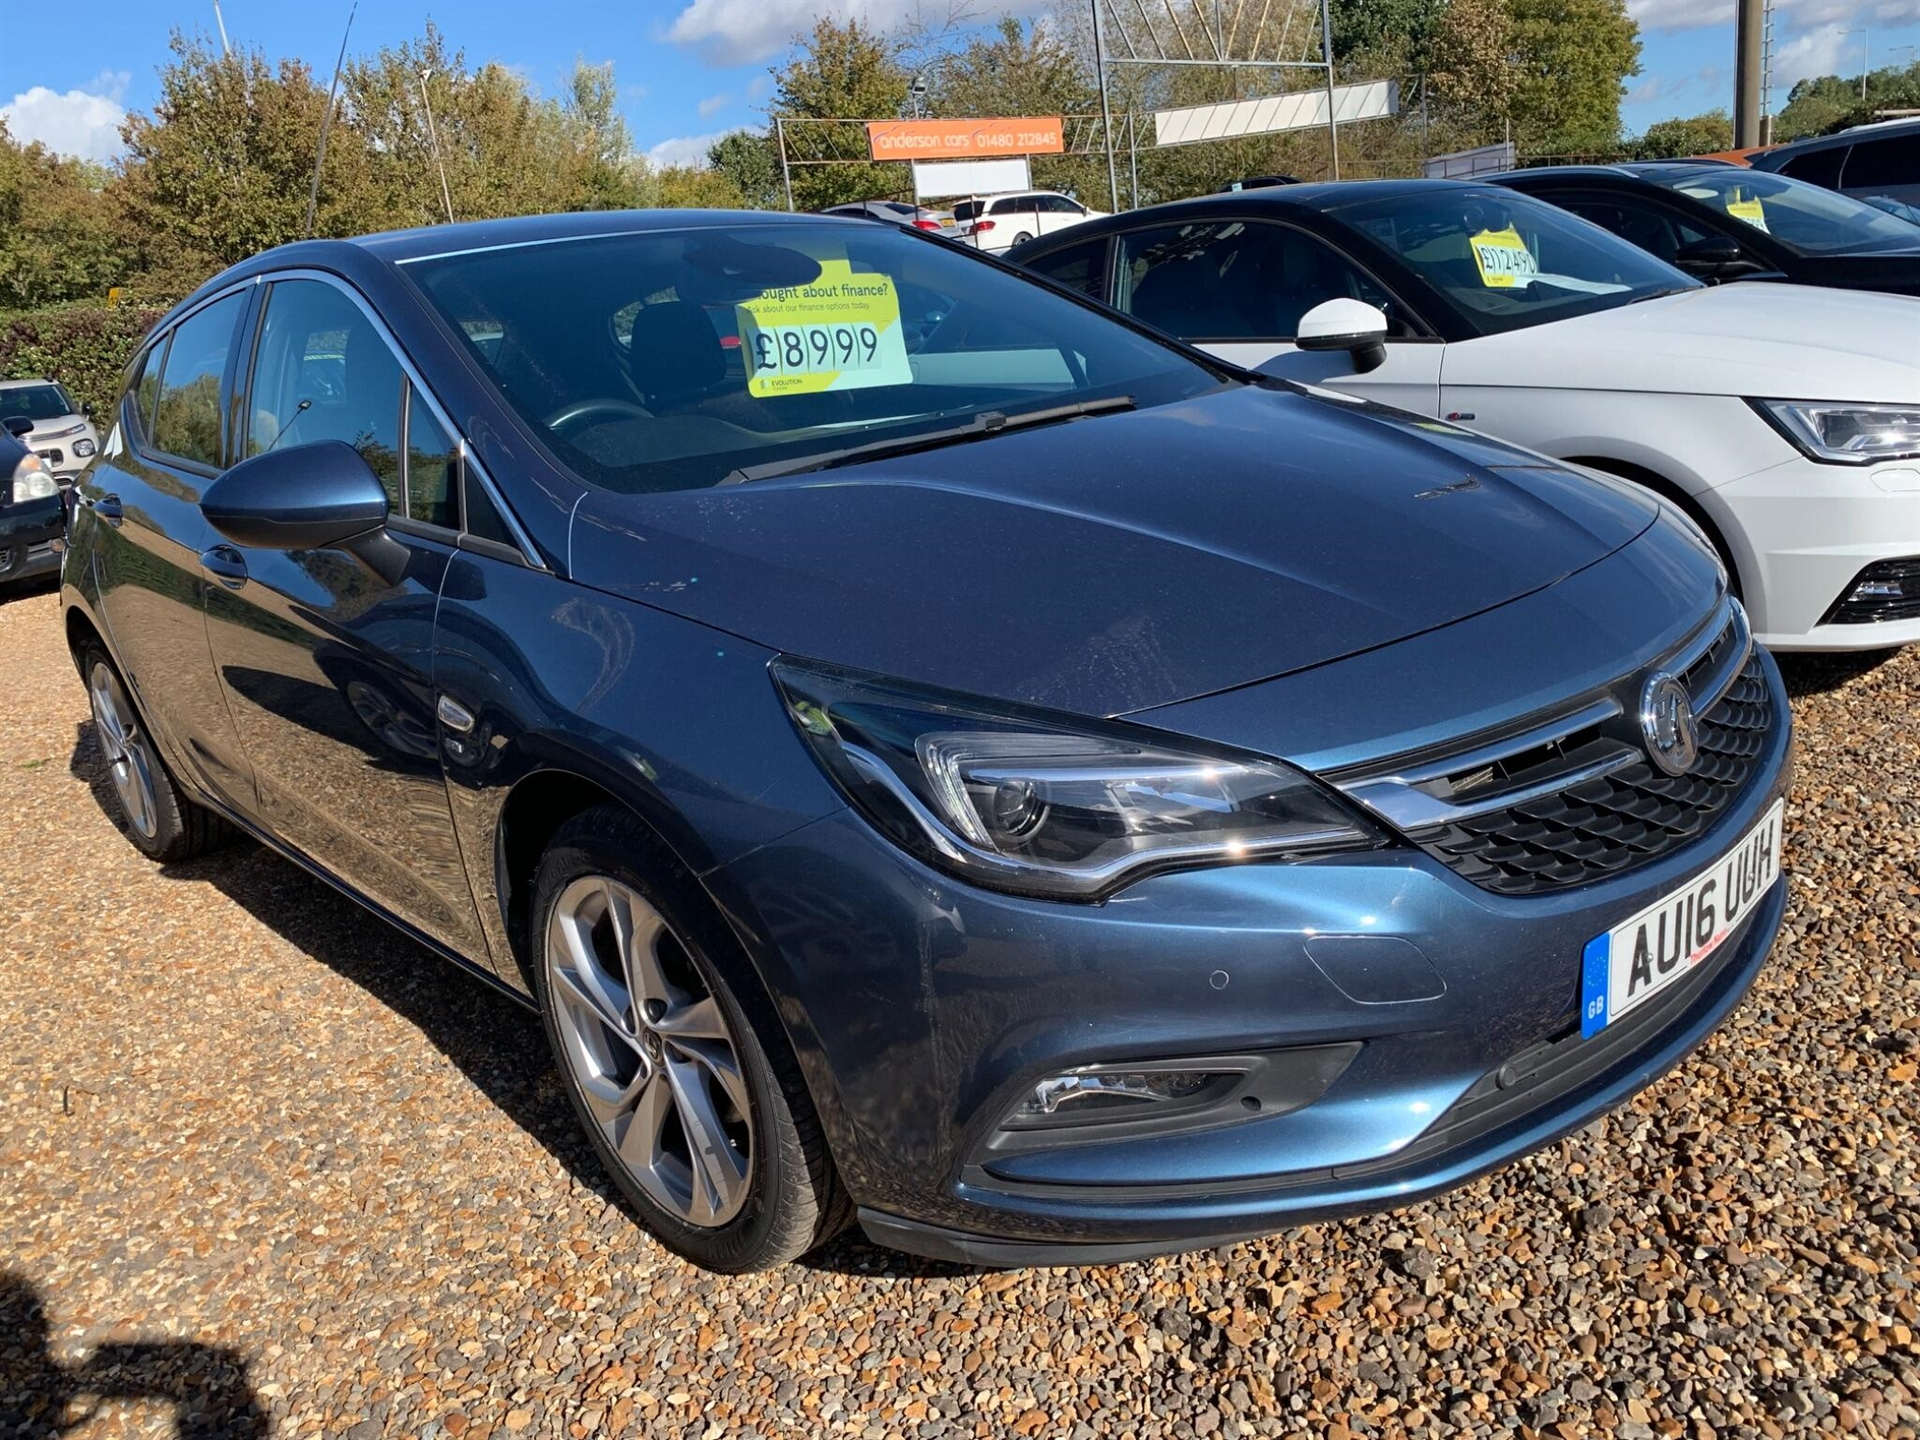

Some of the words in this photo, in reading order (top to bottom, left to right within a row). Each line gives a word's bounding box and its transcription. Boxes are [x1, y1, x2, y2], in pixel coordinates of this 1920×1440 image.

[880, 131, 941, 149] anderson
[944, 134, 970, 148] cars
[976, 133, 1014, 148] 01480
[1017, 131, 1057, 147] 212845
[758, 286, 798, 302] ought
[803, 285, 839, 298] about
[841, 283, 888, 297] finance?
[763, 305, 784, 313] about
[799, 303, 825, 312] finance
[826, 302, 850, 312] options
[755, 327, 877, 370] £8999
[1627, 878, 1716, 998] AU16
[1588, 995, 1604, 1019] GB
